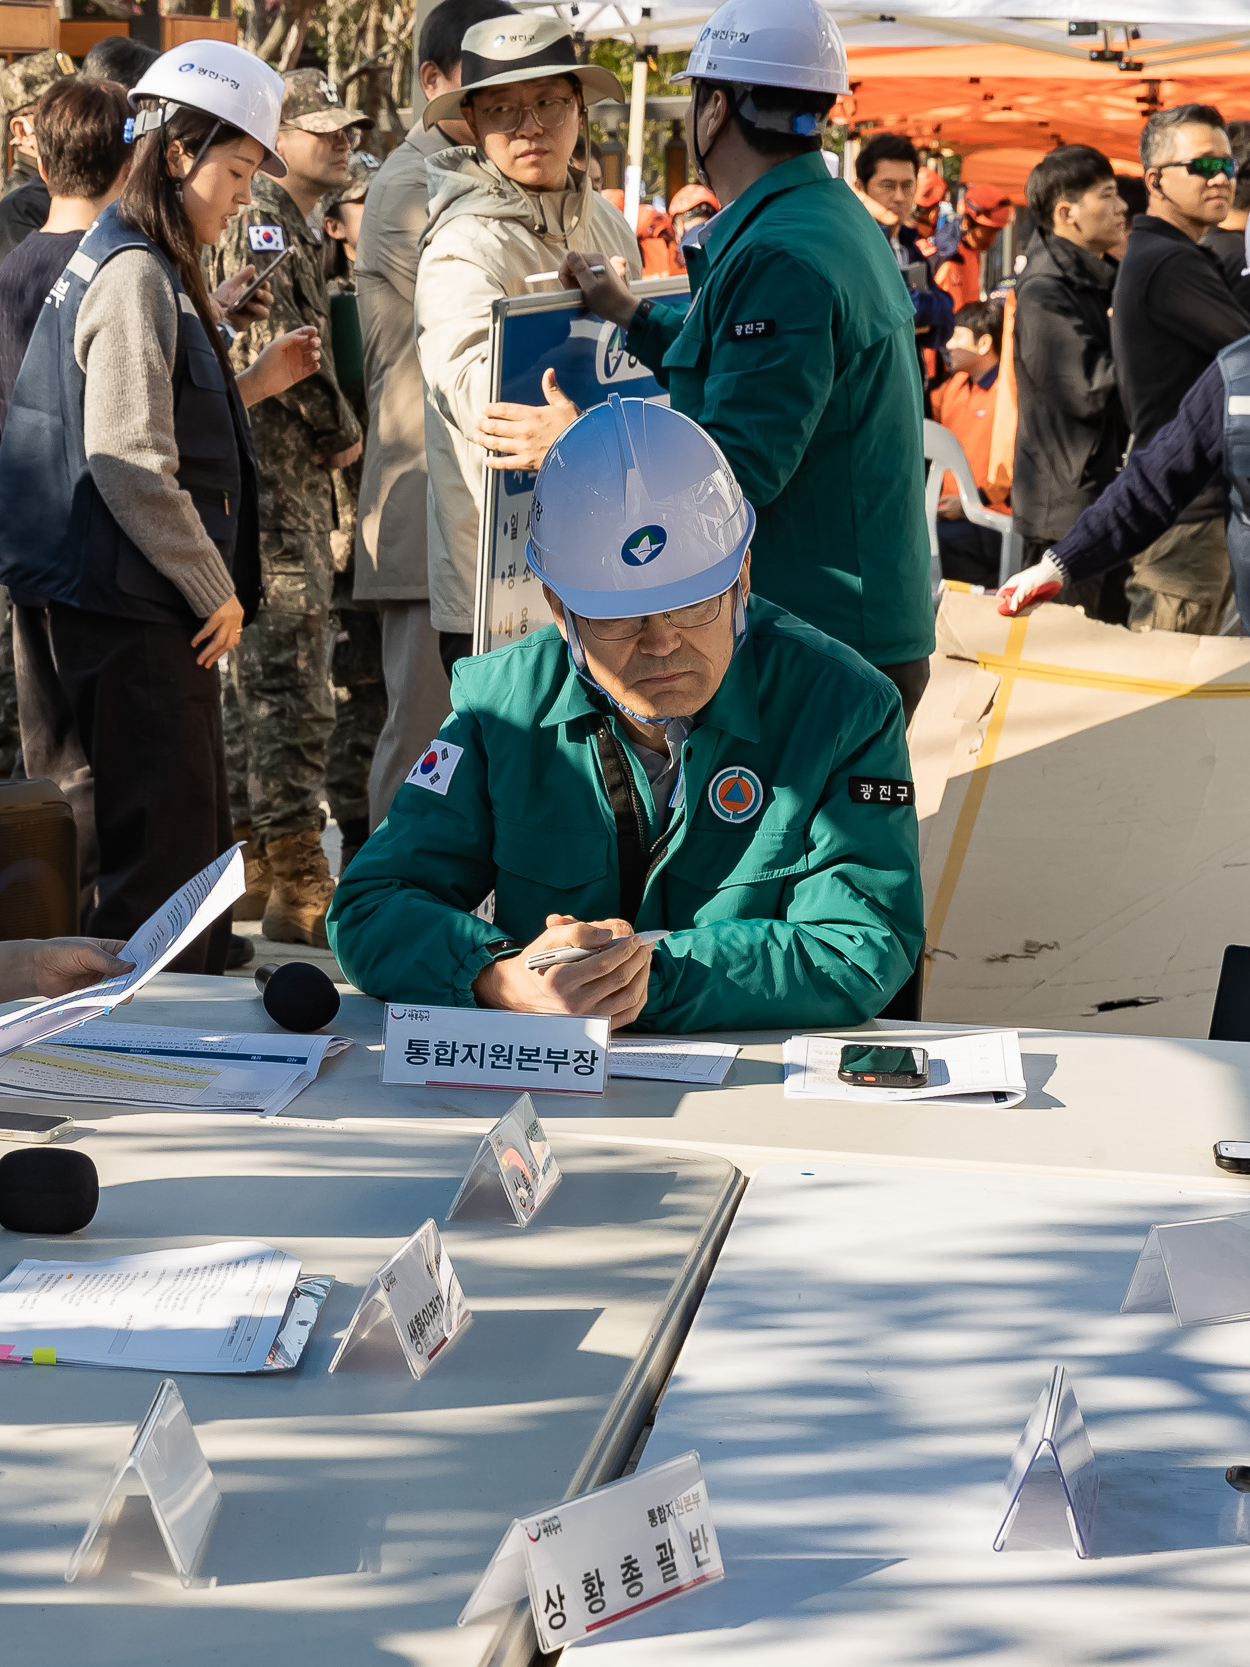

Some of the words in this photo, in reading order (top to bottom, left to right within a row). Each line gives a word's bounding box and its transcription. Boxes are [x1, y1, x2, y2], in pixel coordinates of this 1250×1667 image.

[711, 30, 750, 44] 광진구청
[198, 66, 240, 90] 광진구청
[734, 322, 765, 336] 광진구
[859, 783, 909, 802] 광진구
[404, 1037, 599, 1076] 통합지원본부장
[646, 1491, 702, 1529] 통합지원본부
[543, 1523, 712, 1631] 상황총괄반
